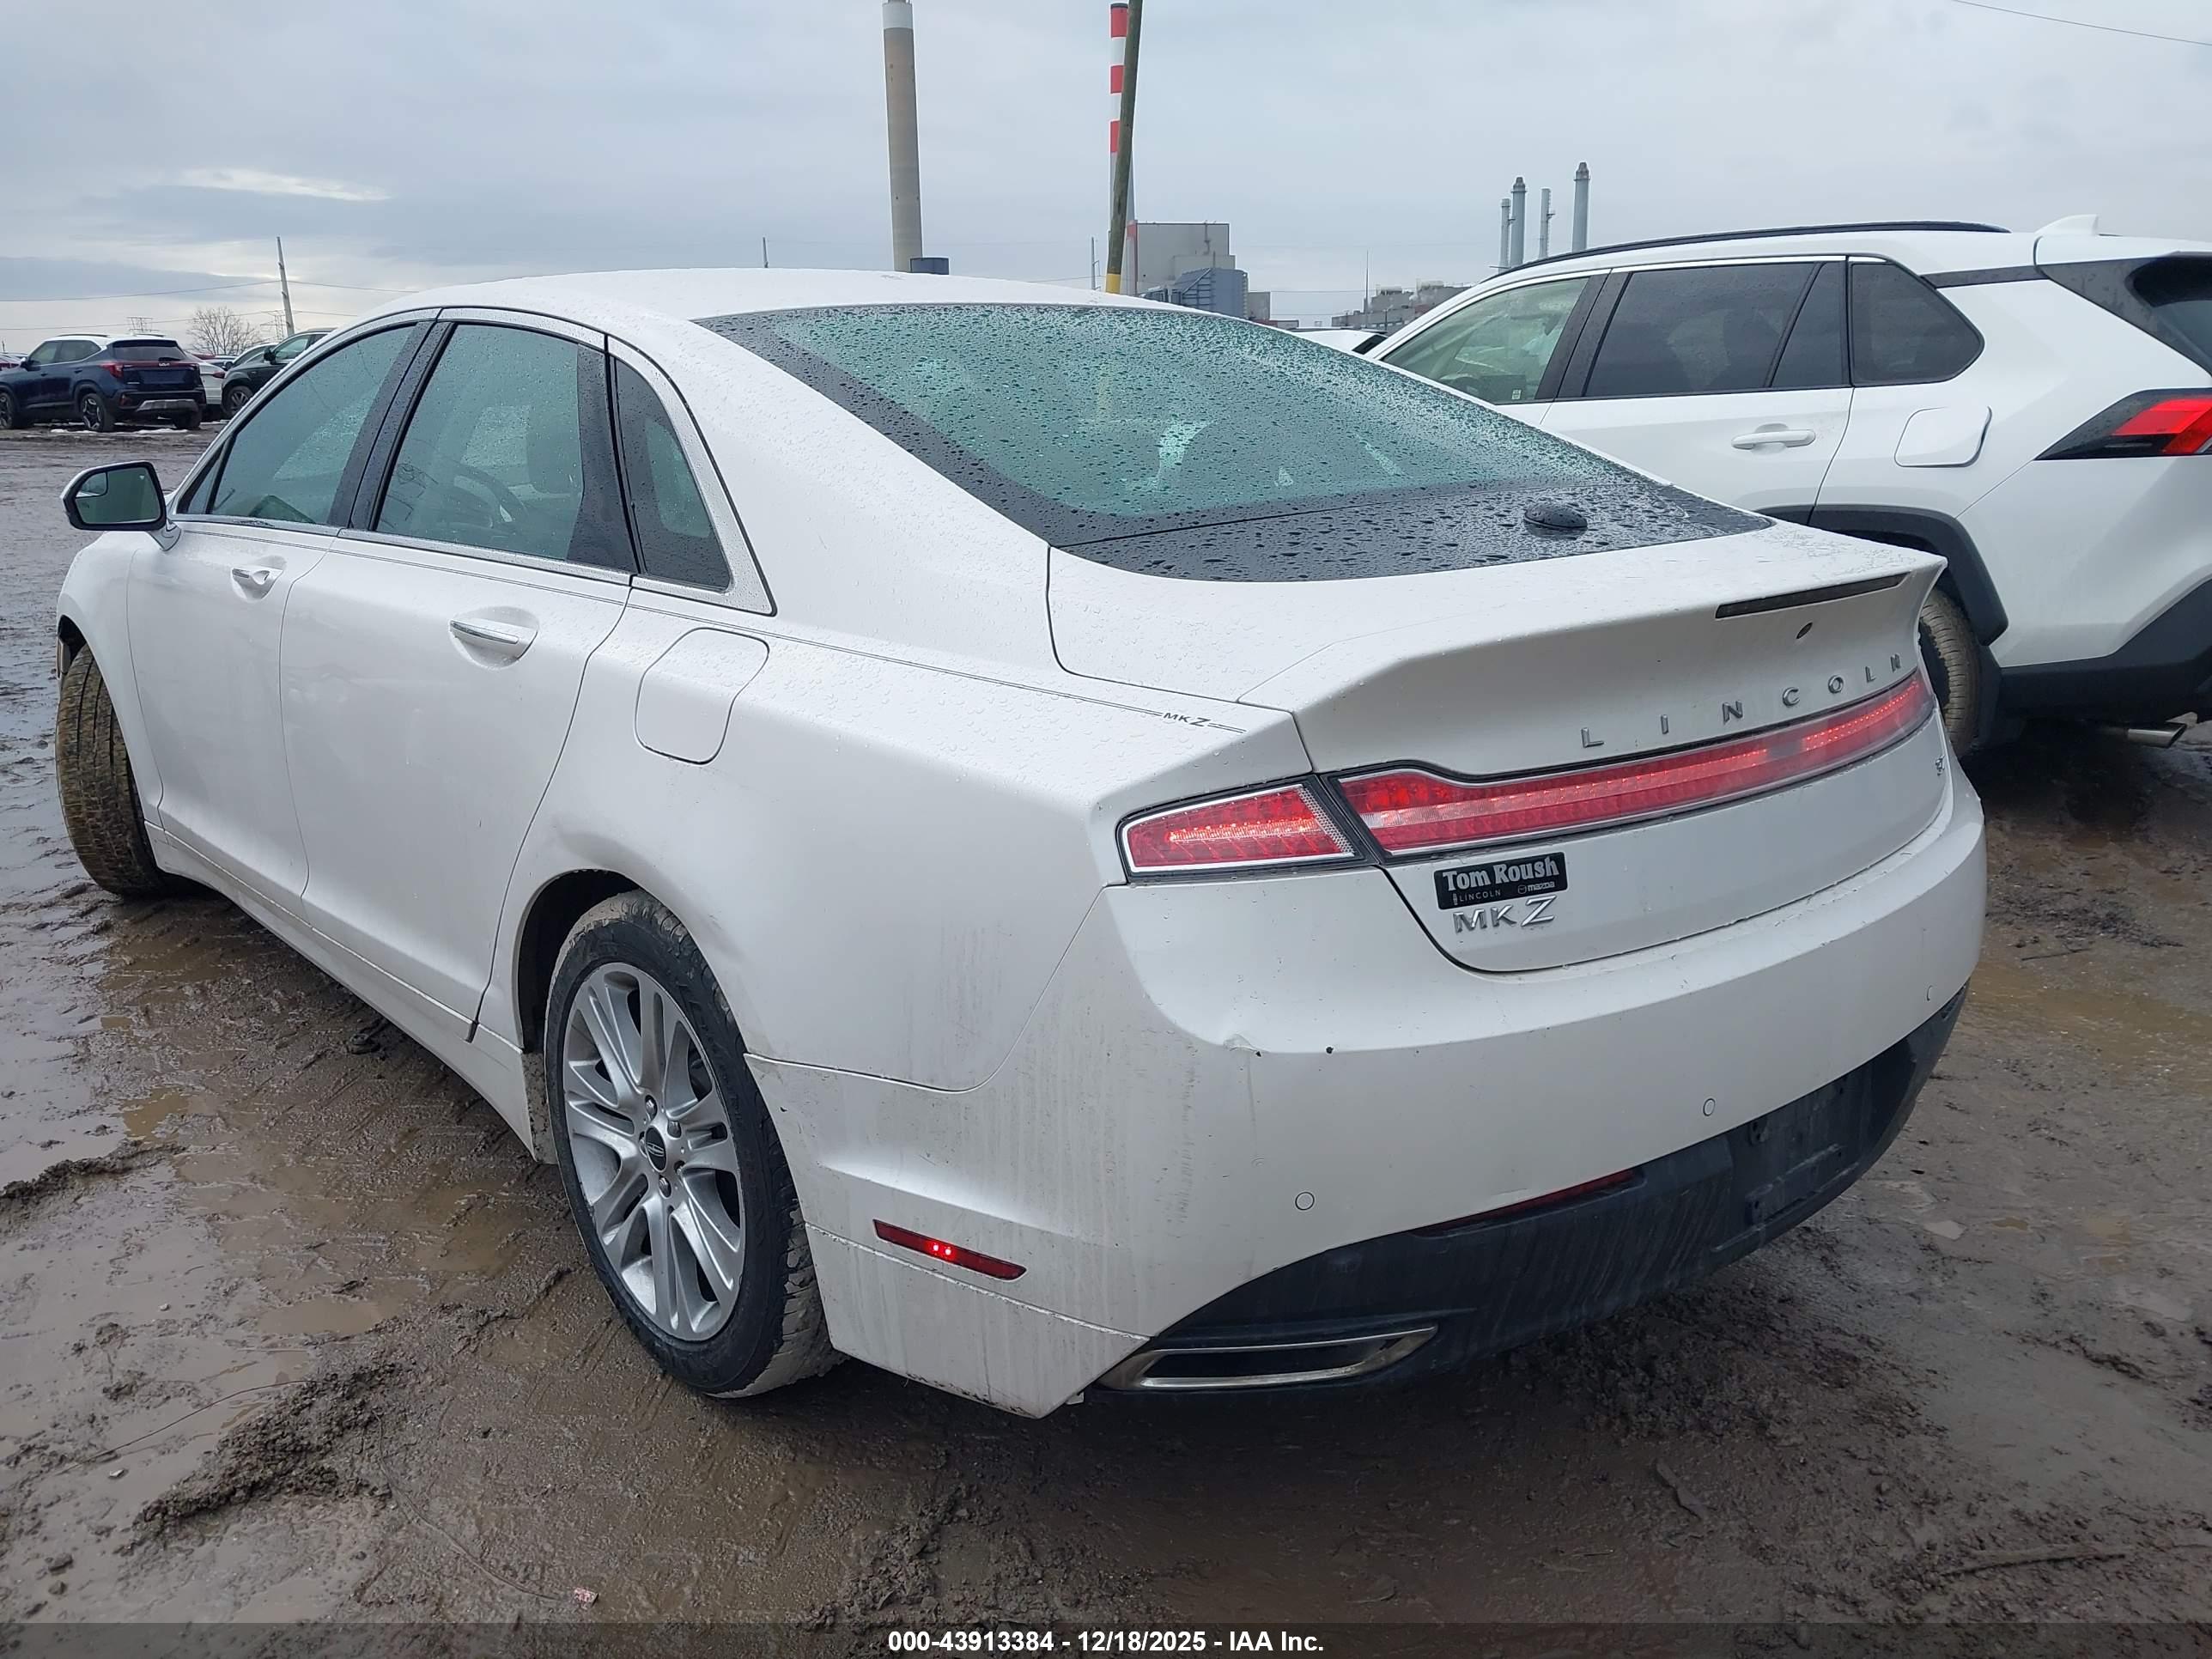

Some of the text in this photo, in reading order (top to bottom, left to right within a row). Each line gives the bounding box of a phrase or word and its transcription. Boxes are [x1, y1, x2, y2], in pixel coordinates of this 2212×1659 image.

[1163, 712, 1212, 727] MKZ
[1581, 653, 1901, 749] LINCOLN
[1442, 855, 1560, 892] Tom Roush
[1452, 894, 1558, 933] MKZ
[1459, 889, 1502, 902] LINCOLN
